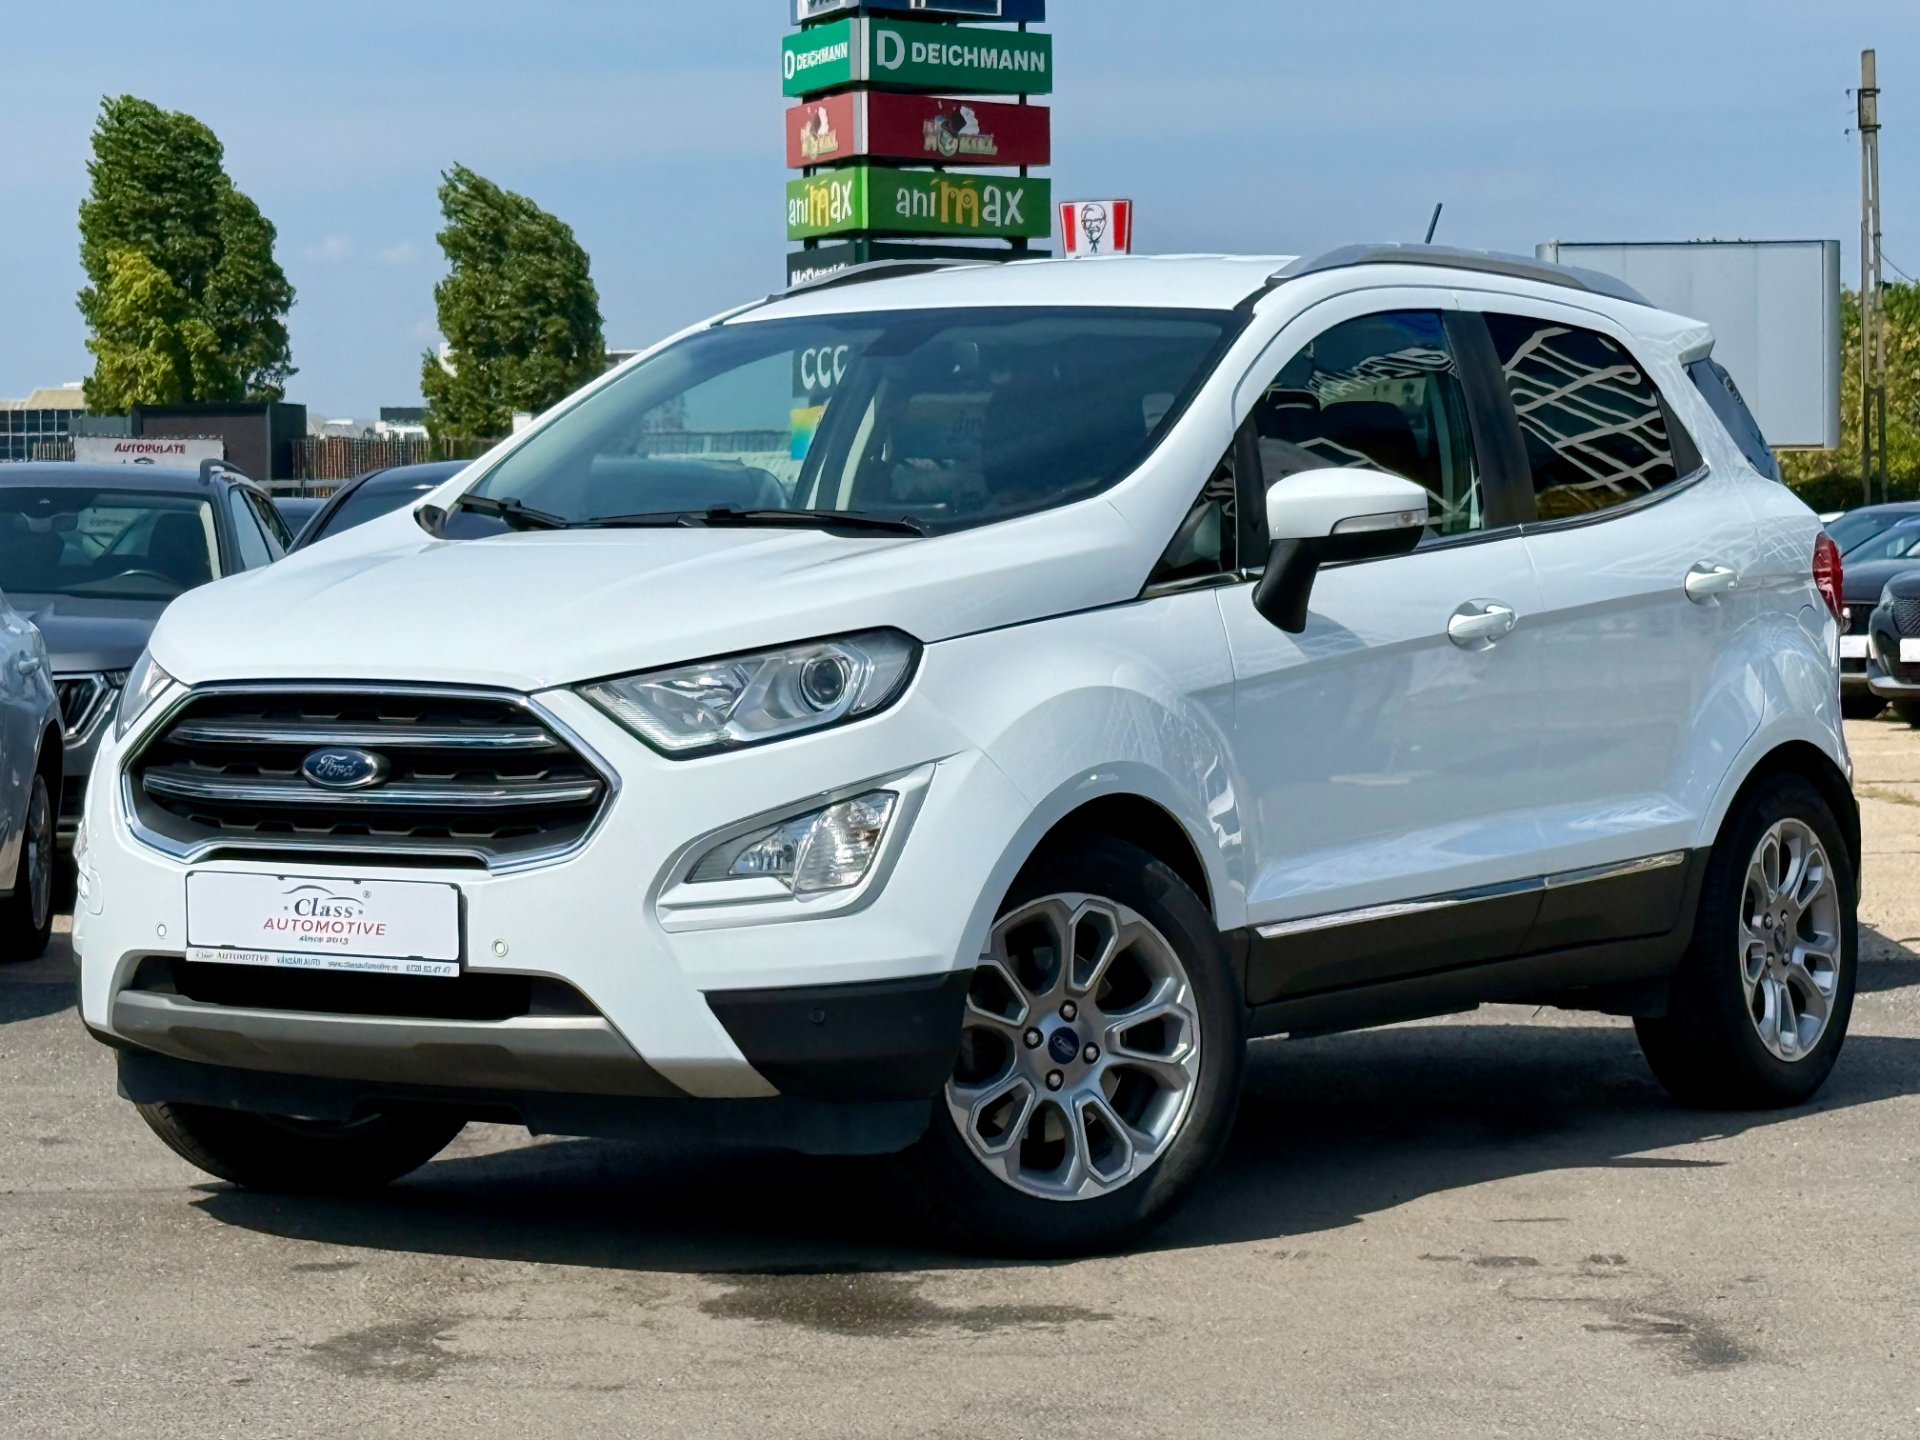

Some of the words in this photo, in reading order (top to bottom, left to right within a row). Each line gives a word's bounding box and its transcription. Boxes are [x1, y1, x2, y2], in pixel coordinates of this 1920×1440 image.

[796, 41, 849, 71] DEICHMANN
[911, 42, 1046, 73] DEICHMANN
[788, 179, 852, 228] animax
[896, 177, 1025, 228] animax
[316, 754, 358, 777] Ford
[294, 897, 354, 919] Class
[263, 918, 387, 936] AUTOMOTIVE
